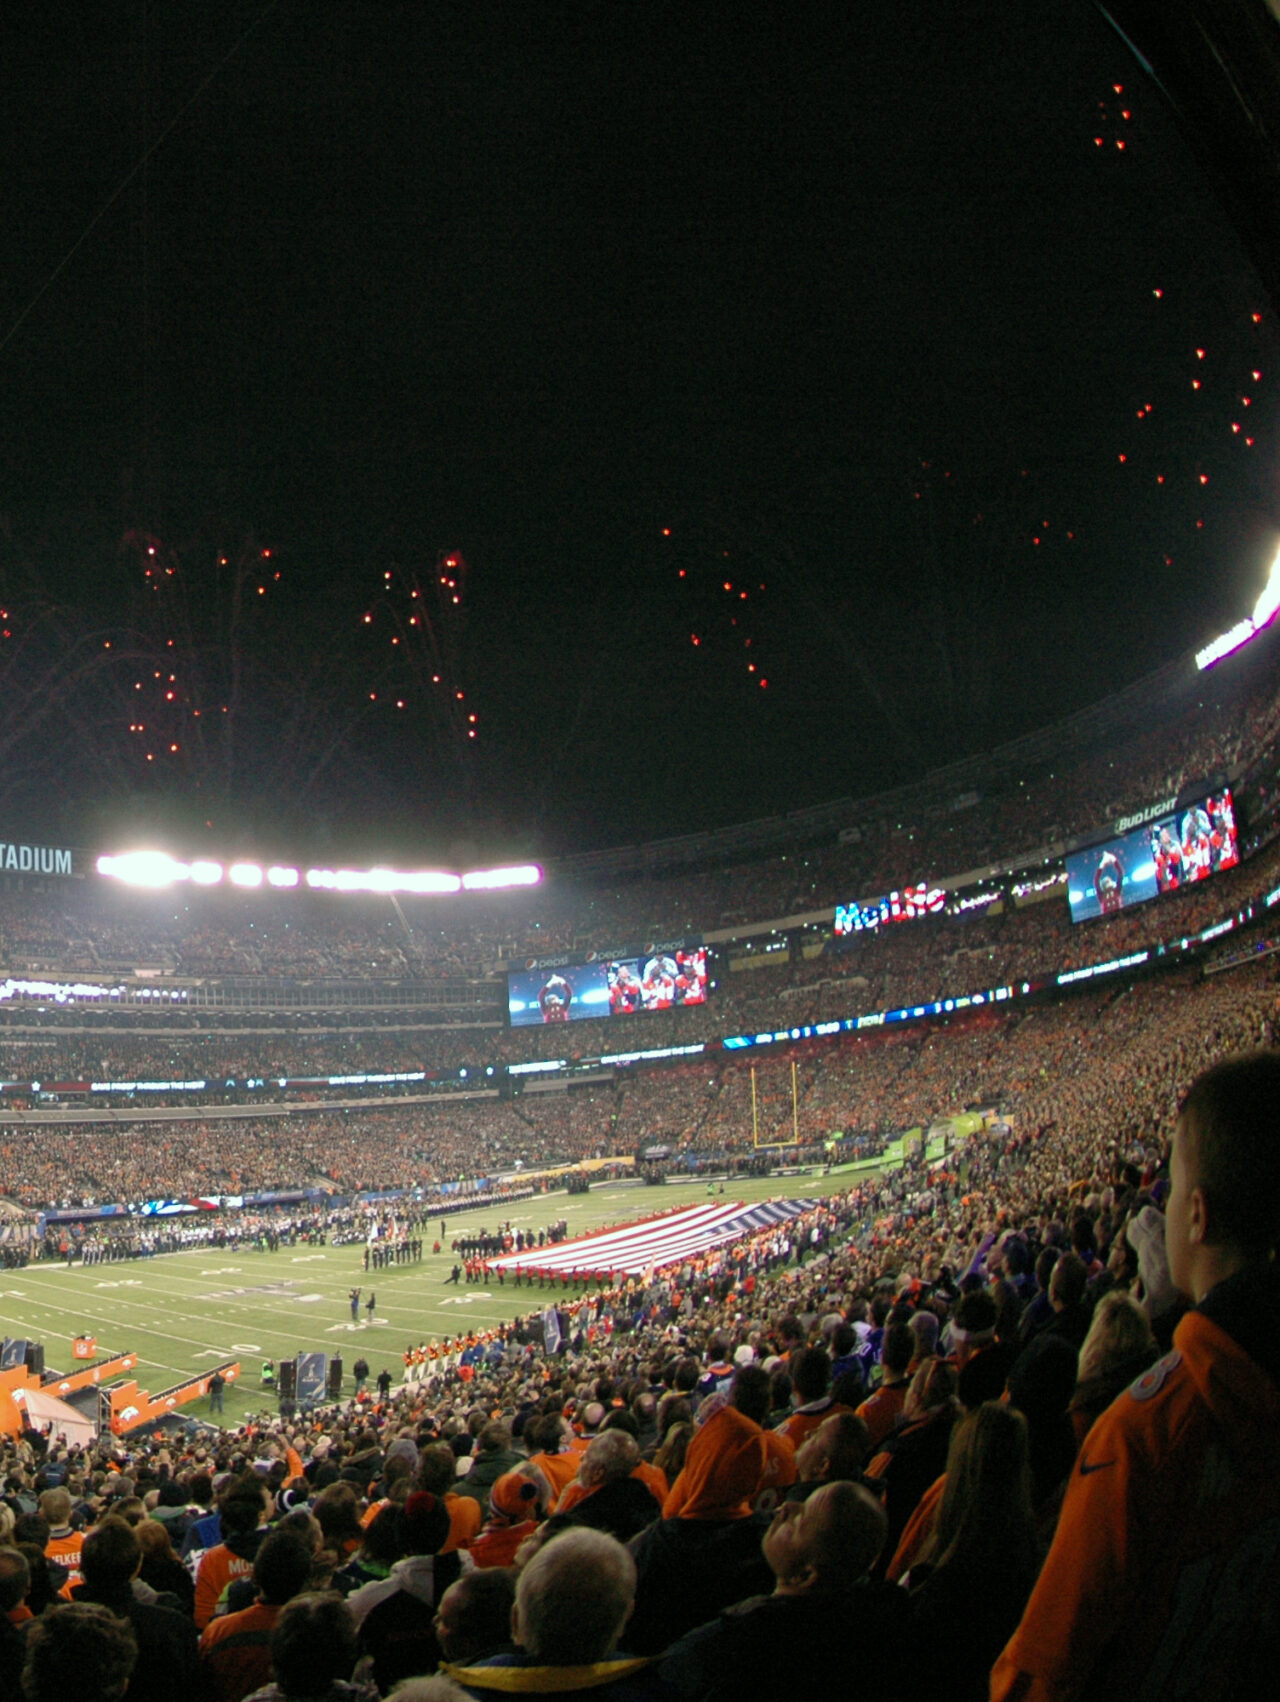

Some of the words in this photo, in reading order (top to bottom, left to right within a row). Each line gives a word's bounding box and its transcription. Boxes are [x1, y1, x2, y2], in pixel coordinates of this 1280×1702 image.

[1119, 812, 1143, 832] BUD
[1143, 797, 1179, 821] LIGHT
[834, 882, 946, 937] MetLife
[538, 957, 569, 970] pepsi
